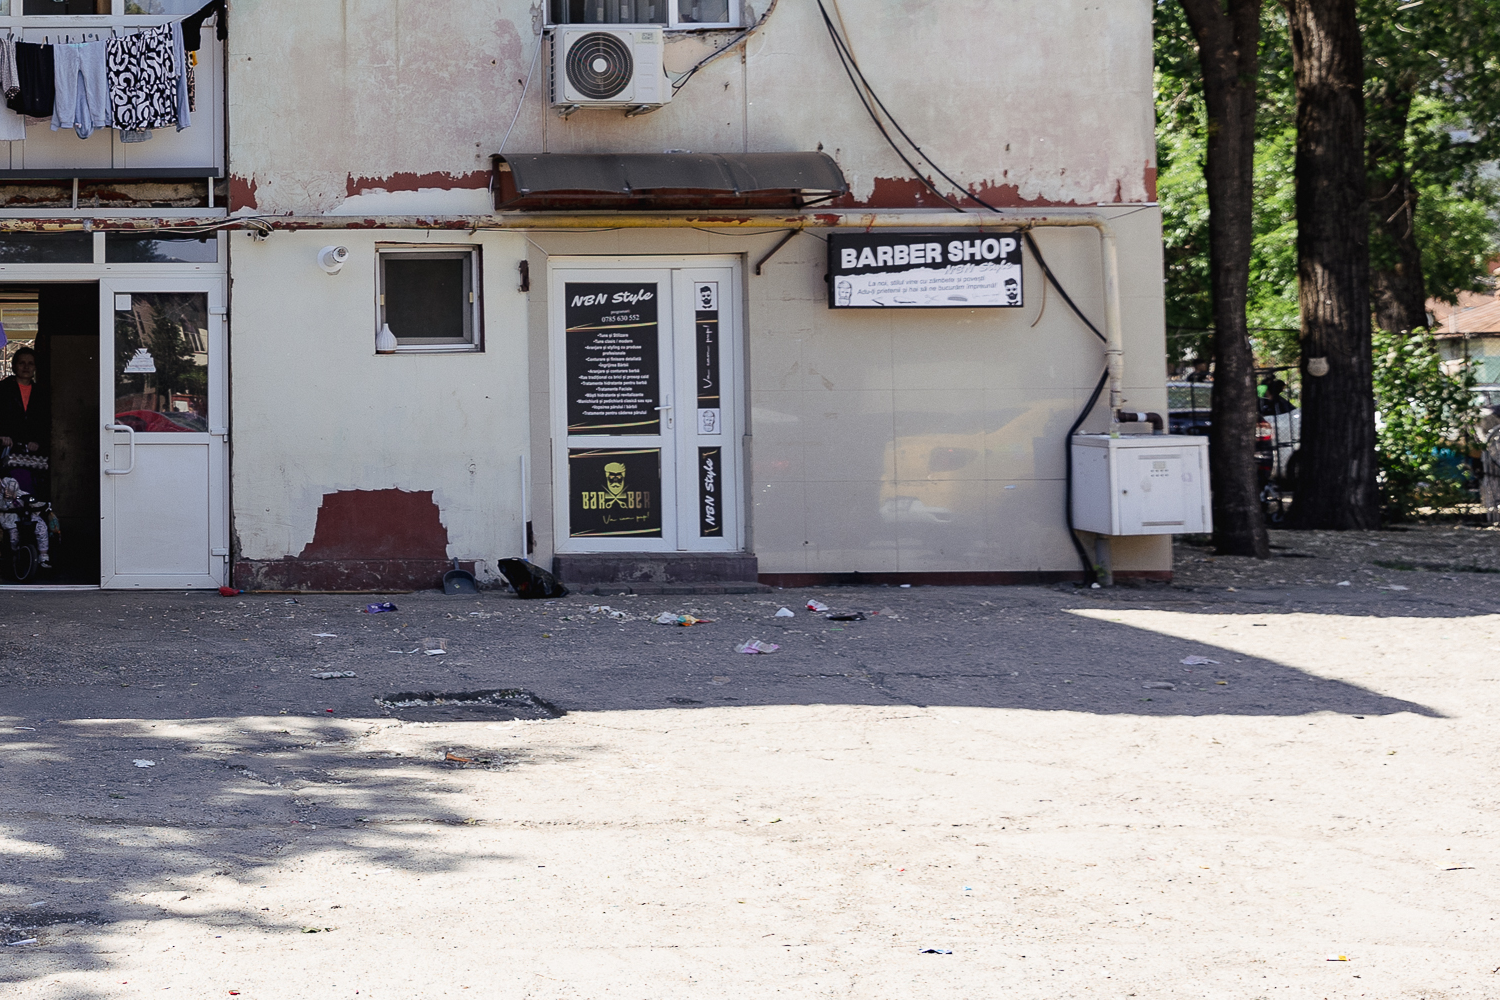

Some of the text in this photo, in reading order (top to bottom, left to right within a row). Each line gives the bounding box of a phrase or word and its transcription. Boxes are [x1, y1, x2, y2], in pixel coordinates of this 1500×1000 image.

[841, 237, 1016, 269] BARBER SHOP
[571, 289, 654, 307] NBN Style
[702, 458, 717, 525] NBN Style
